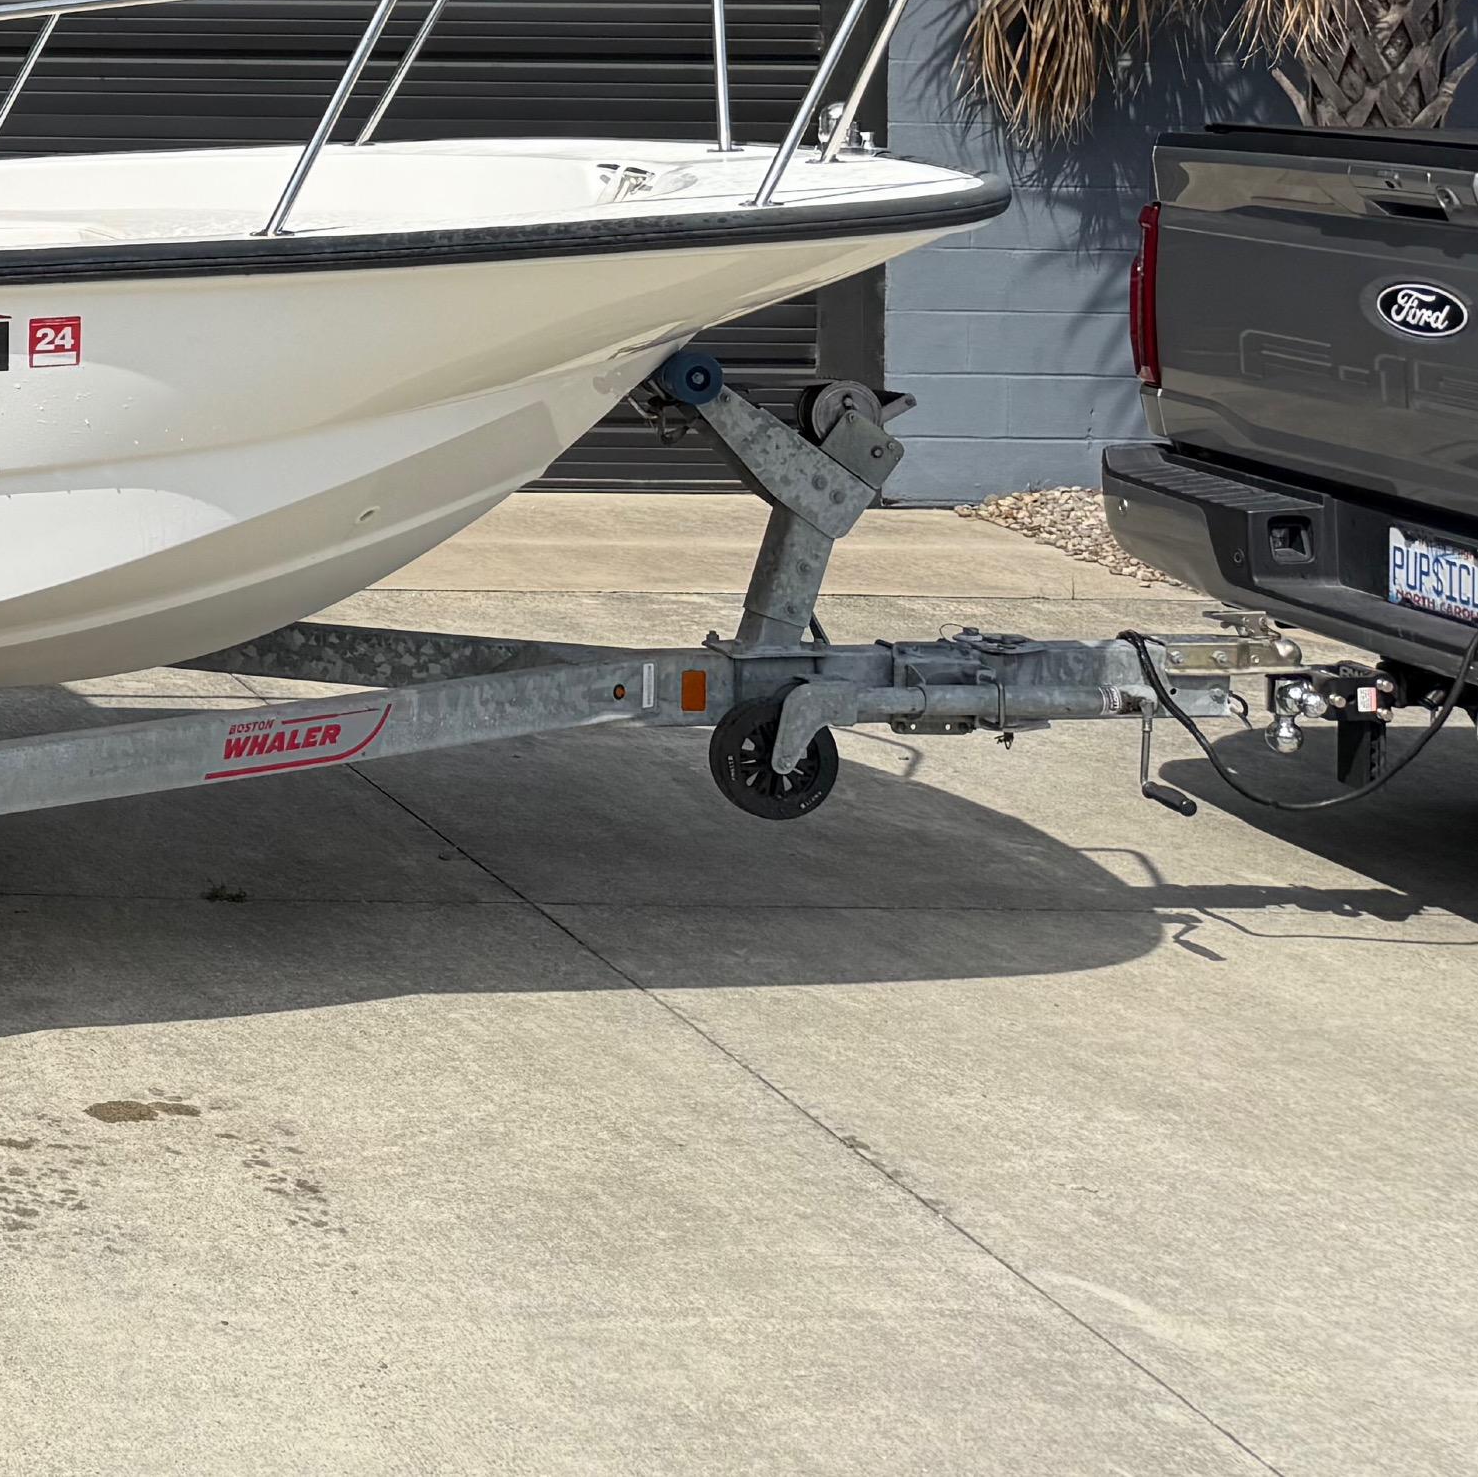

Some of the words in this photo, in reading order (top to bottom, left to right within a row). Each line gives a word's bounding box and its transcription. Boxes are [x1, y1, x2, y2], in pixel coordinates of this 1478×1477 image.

[1391, 289, 1450, 330] Ford
[35, 326, 75, 351] 24
[1392, 545, 1478, 608] PUP$ICL
[1396, 588, 1436, 611] NORTH
[223, 724, 342, 760] WHALER
[228, 719, 274, 735] BOSTON
